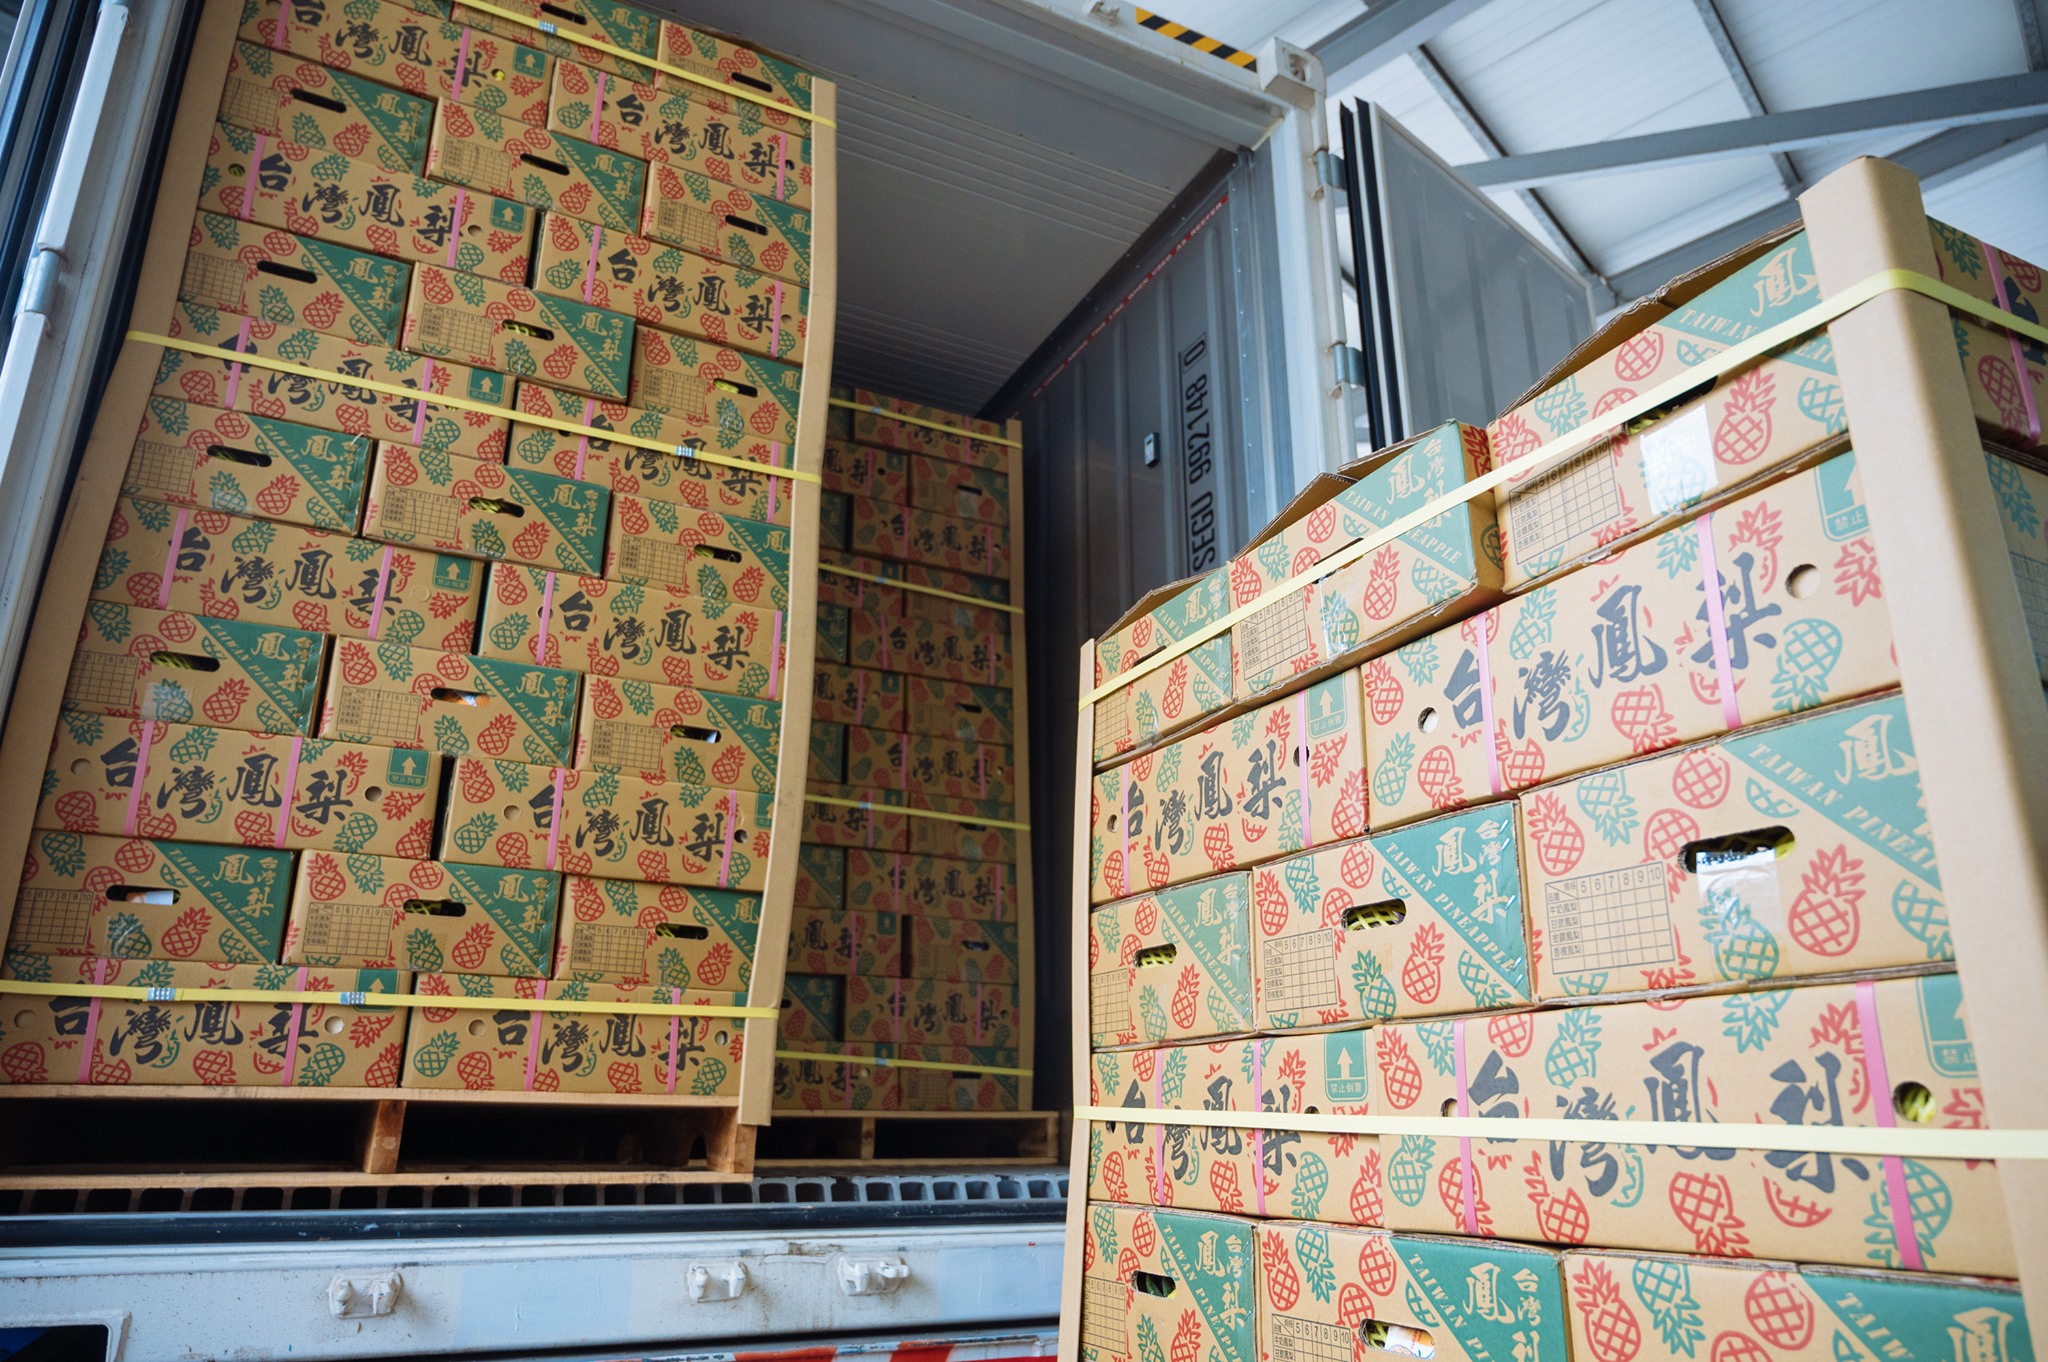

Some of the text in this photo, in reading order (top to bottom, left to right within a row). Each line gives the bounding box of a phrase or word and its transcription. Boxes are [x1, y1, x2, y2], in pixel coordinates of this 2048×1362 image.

[616, 94, 779, 178] 台灣鳳梨
[259, 153, 463, 247] 台灣鳳梨
[608, 249, 776, 334] 台灣鳳梨
[1679, 309, 1758, 340] TAIWAN
[1184, 340, 1216, 572] SEGU 992148 0
[1539, 443, 1608, 487] 5 6 7 8 9 10
[1345, 491, 1462, 563] TAIWAN EAPPLE
[168, 527, 403, 616] 台灣鳳梨
[559, 591, 750, 671] 台灣鳳梨
[1158, 609, 1226, 679] TAIWAN EAPPLE
[1444, 553, 1782, 742] 台灣鳳梨
[100, 738, 353, 824] 台灣鳳梨
[1121, 740, 1286, 854] 台灣鳳梨
[1749, 744, 1843, 805] TAIWAN
[529, 784, 726, 862] 台灣鳳梨
[1476, 820, 1501, 865] 台灣
[169, 848, 269, 949] TAIWAN PINEAPPLE
[213, 854, 274, 918] 鳳梨
[1386, 843, 1516, 972] TAIWAN PINEAPPLE
[1432, 827, 1509, 924] 鳳梨
[1581, 881, 1587, 893] 5
[1594, 879, 1600, 890] 6
[1608, 876, 1614, 888] 7
[1623, 873, 1629, 885] 8
[1637, 870, 1644, 882] 9
[1650, 867, 1660, 880] 10
[1165, 899, 1243, 1003] TAIWAN PINEAPPLE
[1194, 888, 1241, 966] 鳳梨
[1285, 932, 1330, 950] 5 6 7 8 9 10
[1331, 1082, 1361, 1093] 禁止倒置
[1164, 1225, 1244, 1362] TAIWAN PINEAPP
[1195, 1231, 1247, 1330] 鳳梨
[1225, 1234, 1243, 1278] 台灣
[1409, 1254, 1467, 1328] TAIWAN
[1295, 1323, 1300, 1333] 5
[1305, 1324, 1309, 1335] 6
[1315, 1326, 1318, 1337] 7
[1324, 1328, 1328, 1339] 8
[1334, 1330, 1338, 1341] 9
[1342, 1332, 1349, 1343] 10
[1512, 1268, 1542, 1326] 台灣
